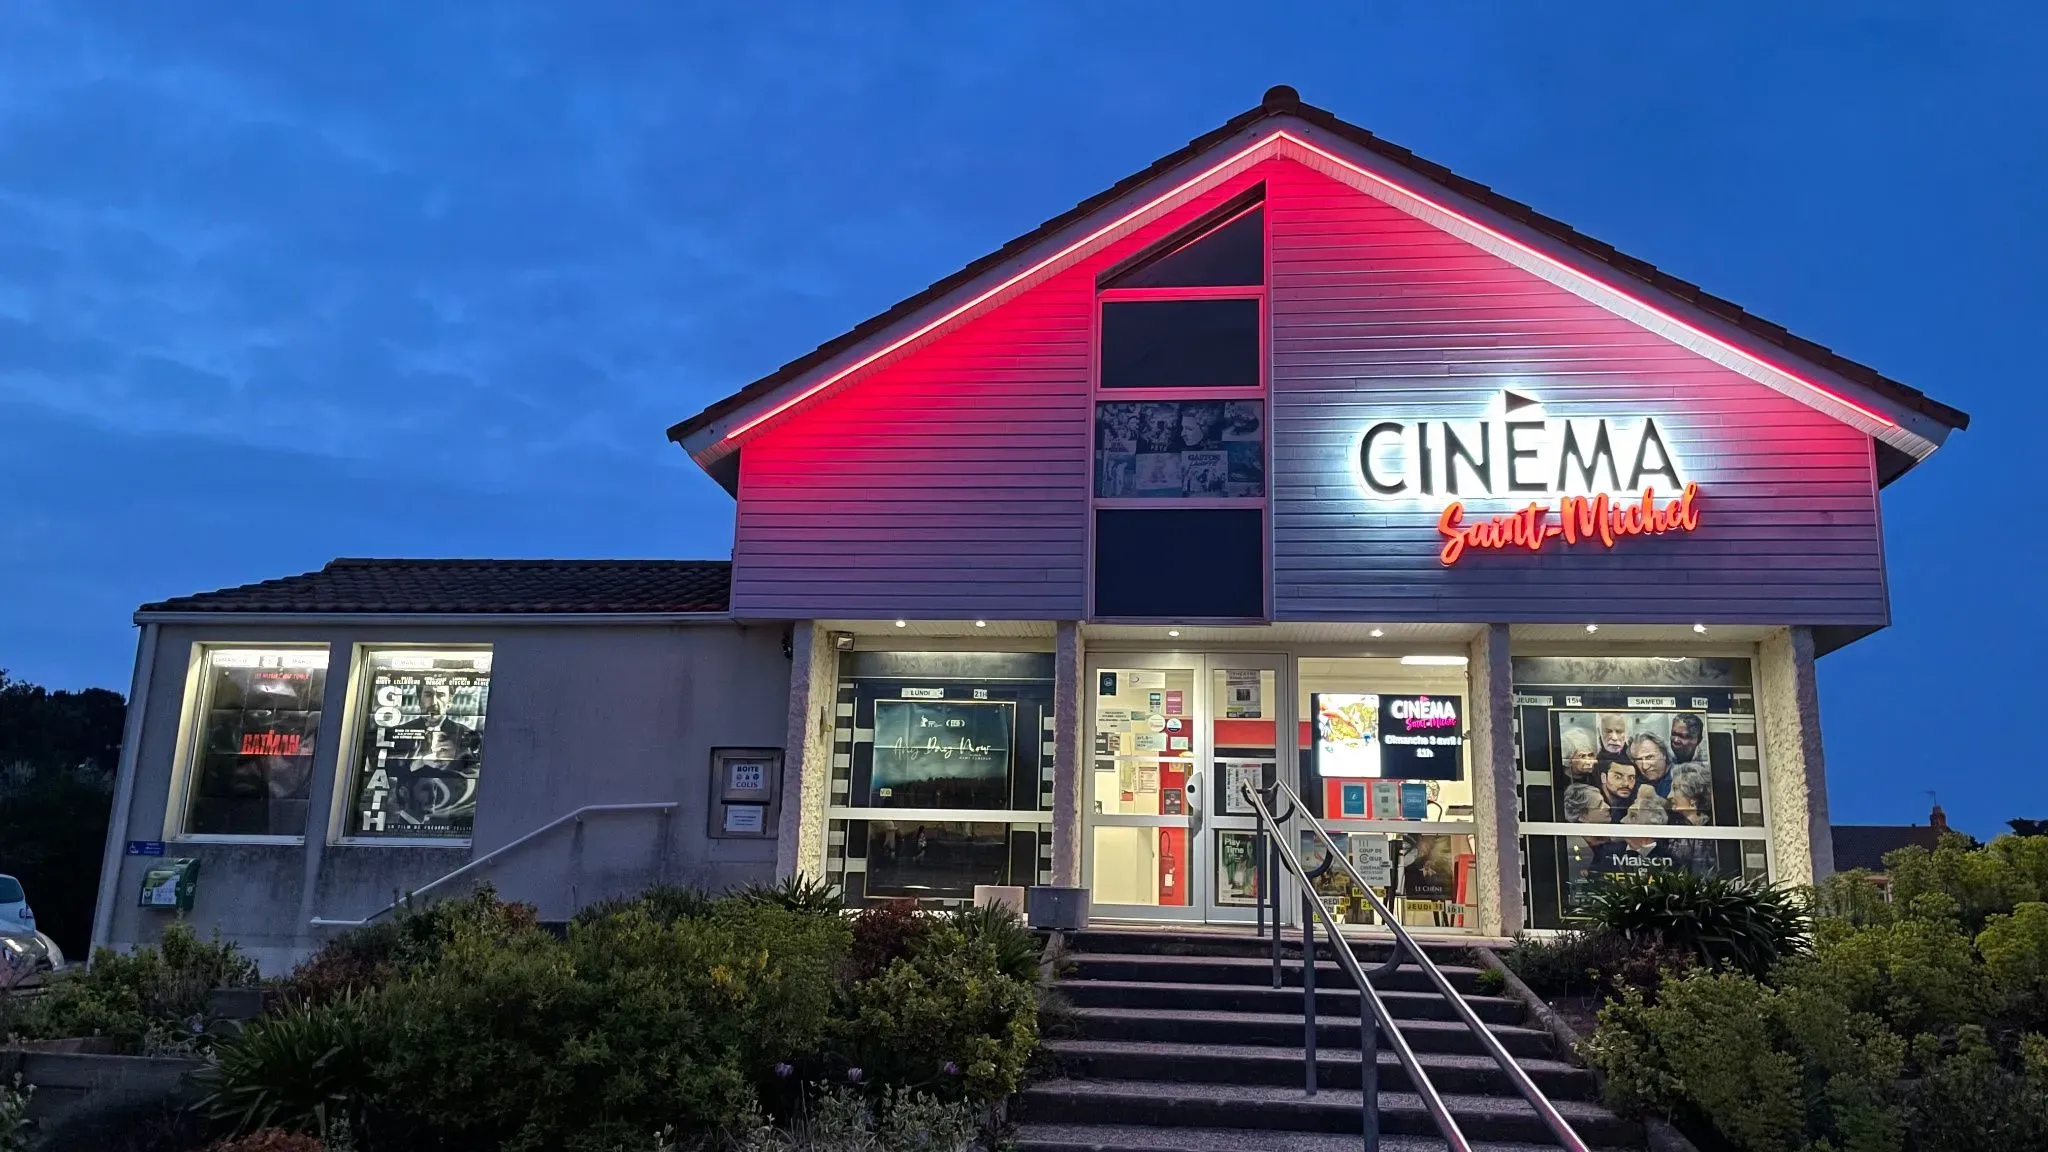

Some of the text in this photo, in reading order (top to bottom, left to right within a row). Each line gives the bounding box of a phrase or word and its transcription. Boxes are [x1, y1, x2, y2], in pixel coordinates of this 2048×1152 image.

[1438, 481, 1699, 567] Saint-Michel
[910, 689, 931, 697] LUNDI
[1516, 697, 1538, 705] JEUDI
[1635, 698, 1664, 706] SAMEDI
[959, 736, 992, 756] Now
[362, 685, 403, 832] GOLIATH
[1224, 837, 1241, 847] Play
[1225, 846, 1245, 854] Time
[1612, 853, 1673, 867] Maison
